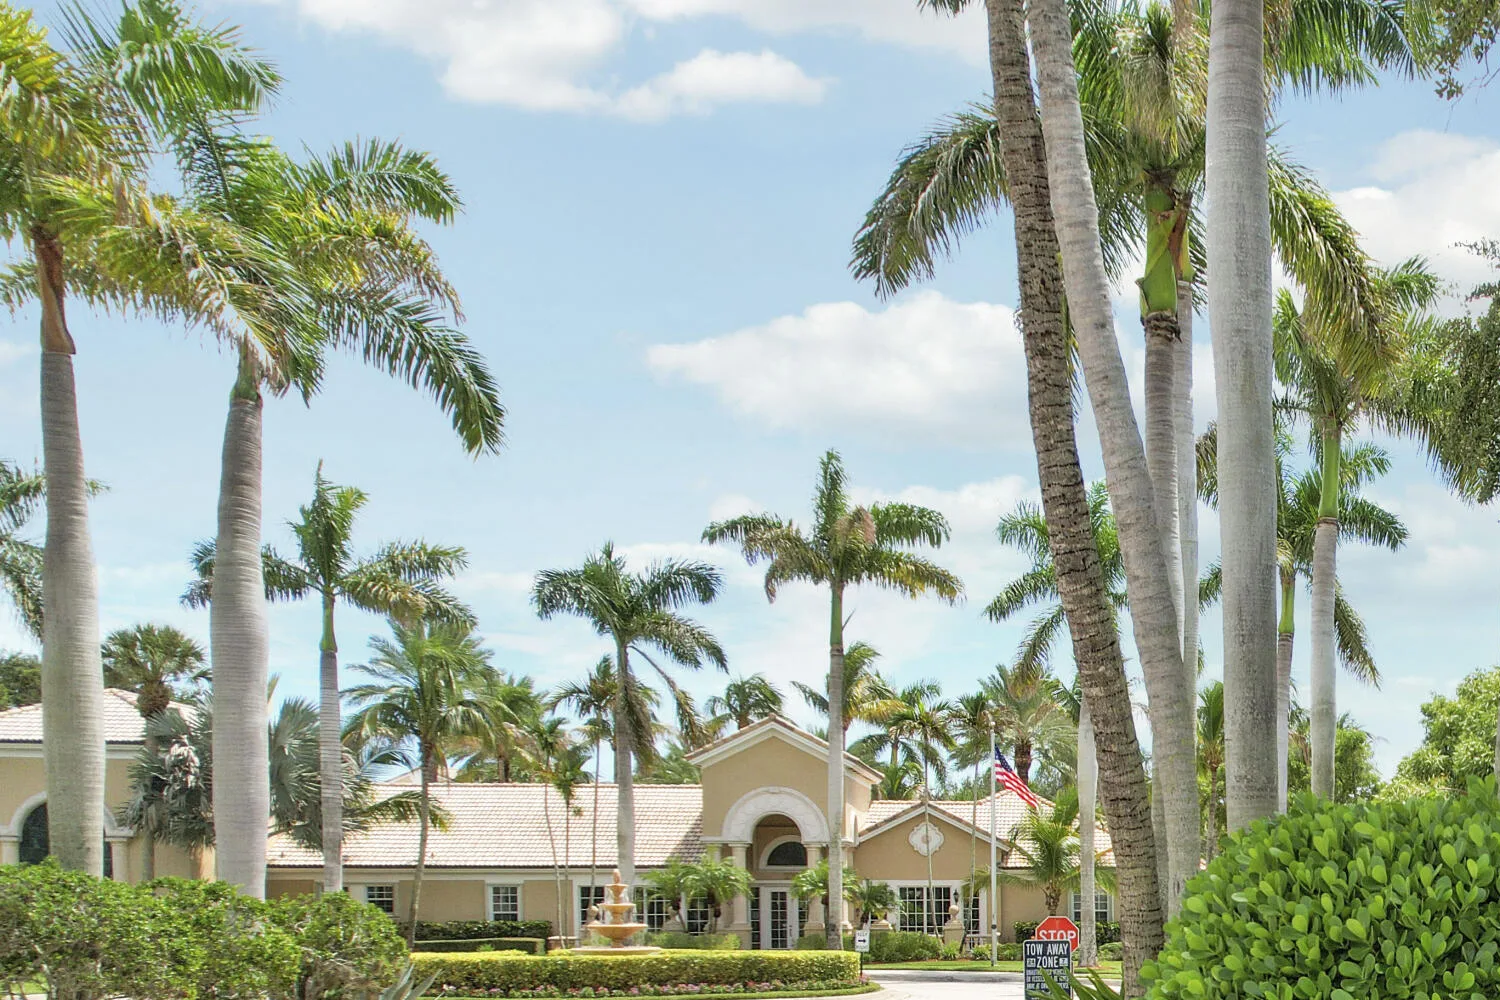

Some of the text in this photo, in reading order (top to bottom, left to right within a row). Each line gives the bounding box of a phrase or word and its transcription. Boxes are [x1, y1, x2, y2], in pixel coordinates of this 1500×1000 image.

[1039, 930, 1076, 940] STOP
[1026, 943, 1068, 956] TOW AWAY
[1037, 956, 1058, 968] ZONE
